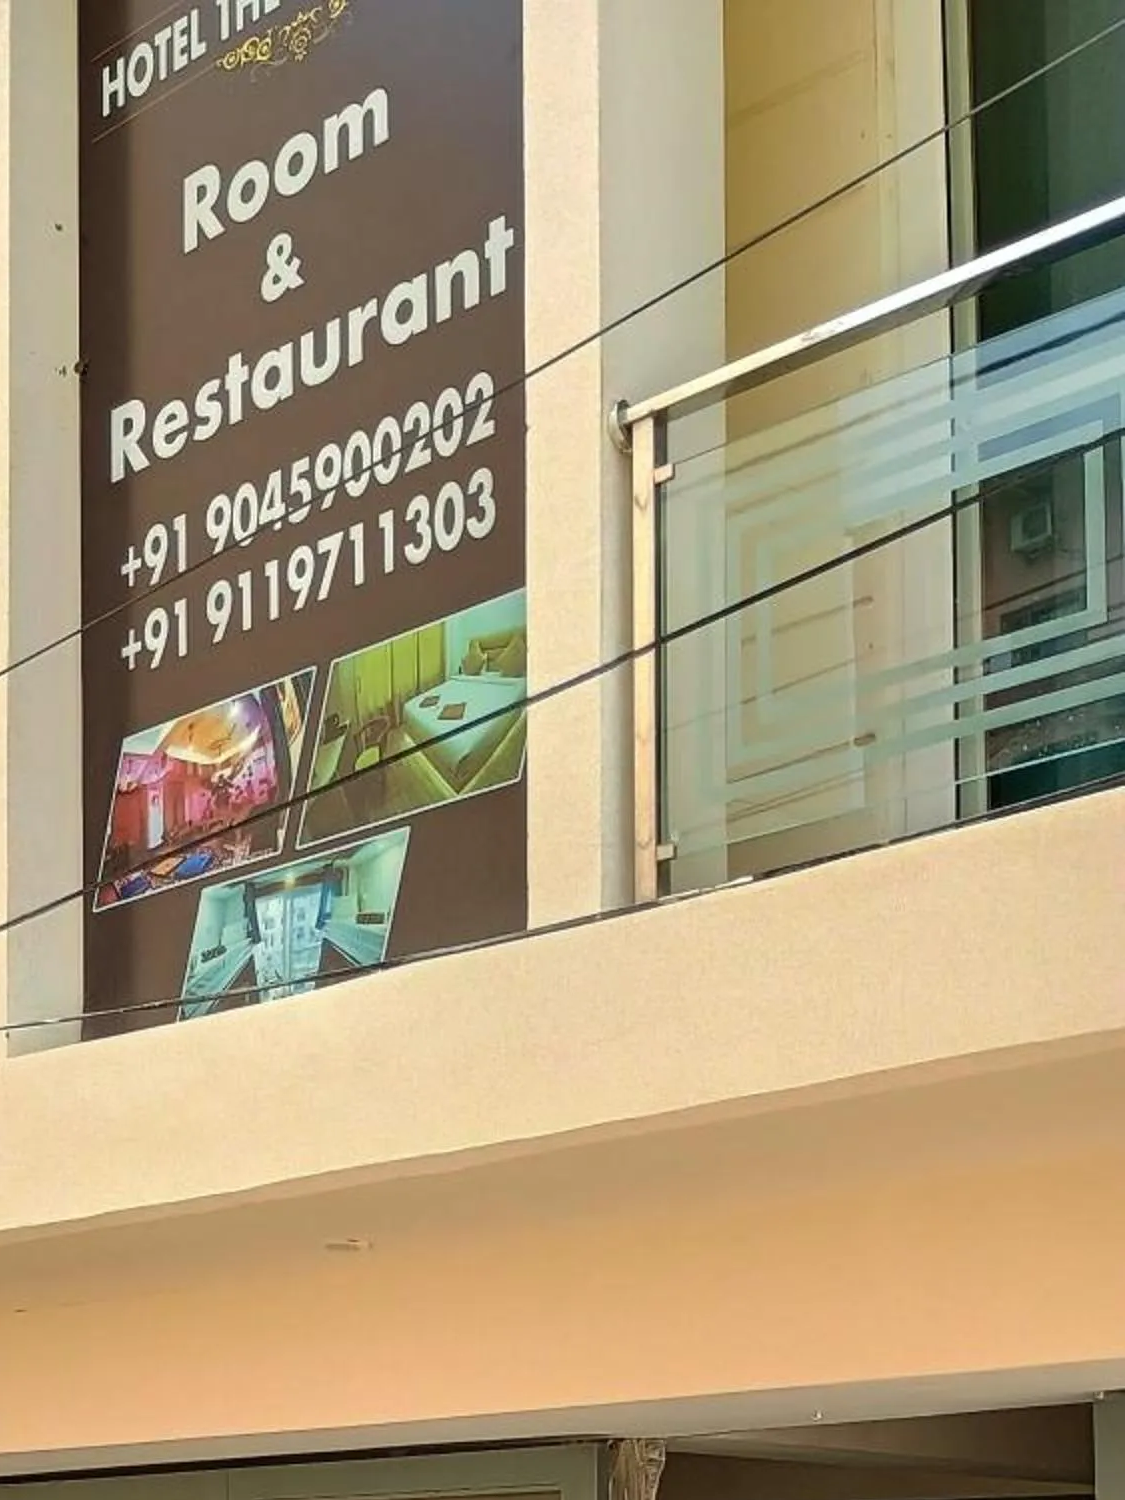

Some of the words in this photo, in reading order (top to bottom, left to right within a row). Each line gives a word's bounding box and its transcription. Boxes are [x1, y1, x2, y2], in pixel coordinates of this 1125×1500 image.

[102, 8, 207, 117] HOTEL
[183, 87, 389, 254] Room
[109, 215, 514, 483] Restaurant
[260, 232, 304, 302] &
[121, 513, 188, 587] +91
[206, 371, 496, 554] 9045900202
[121, 598, 188, 669] +91
[206, 468, 496, 643] 9119711303
